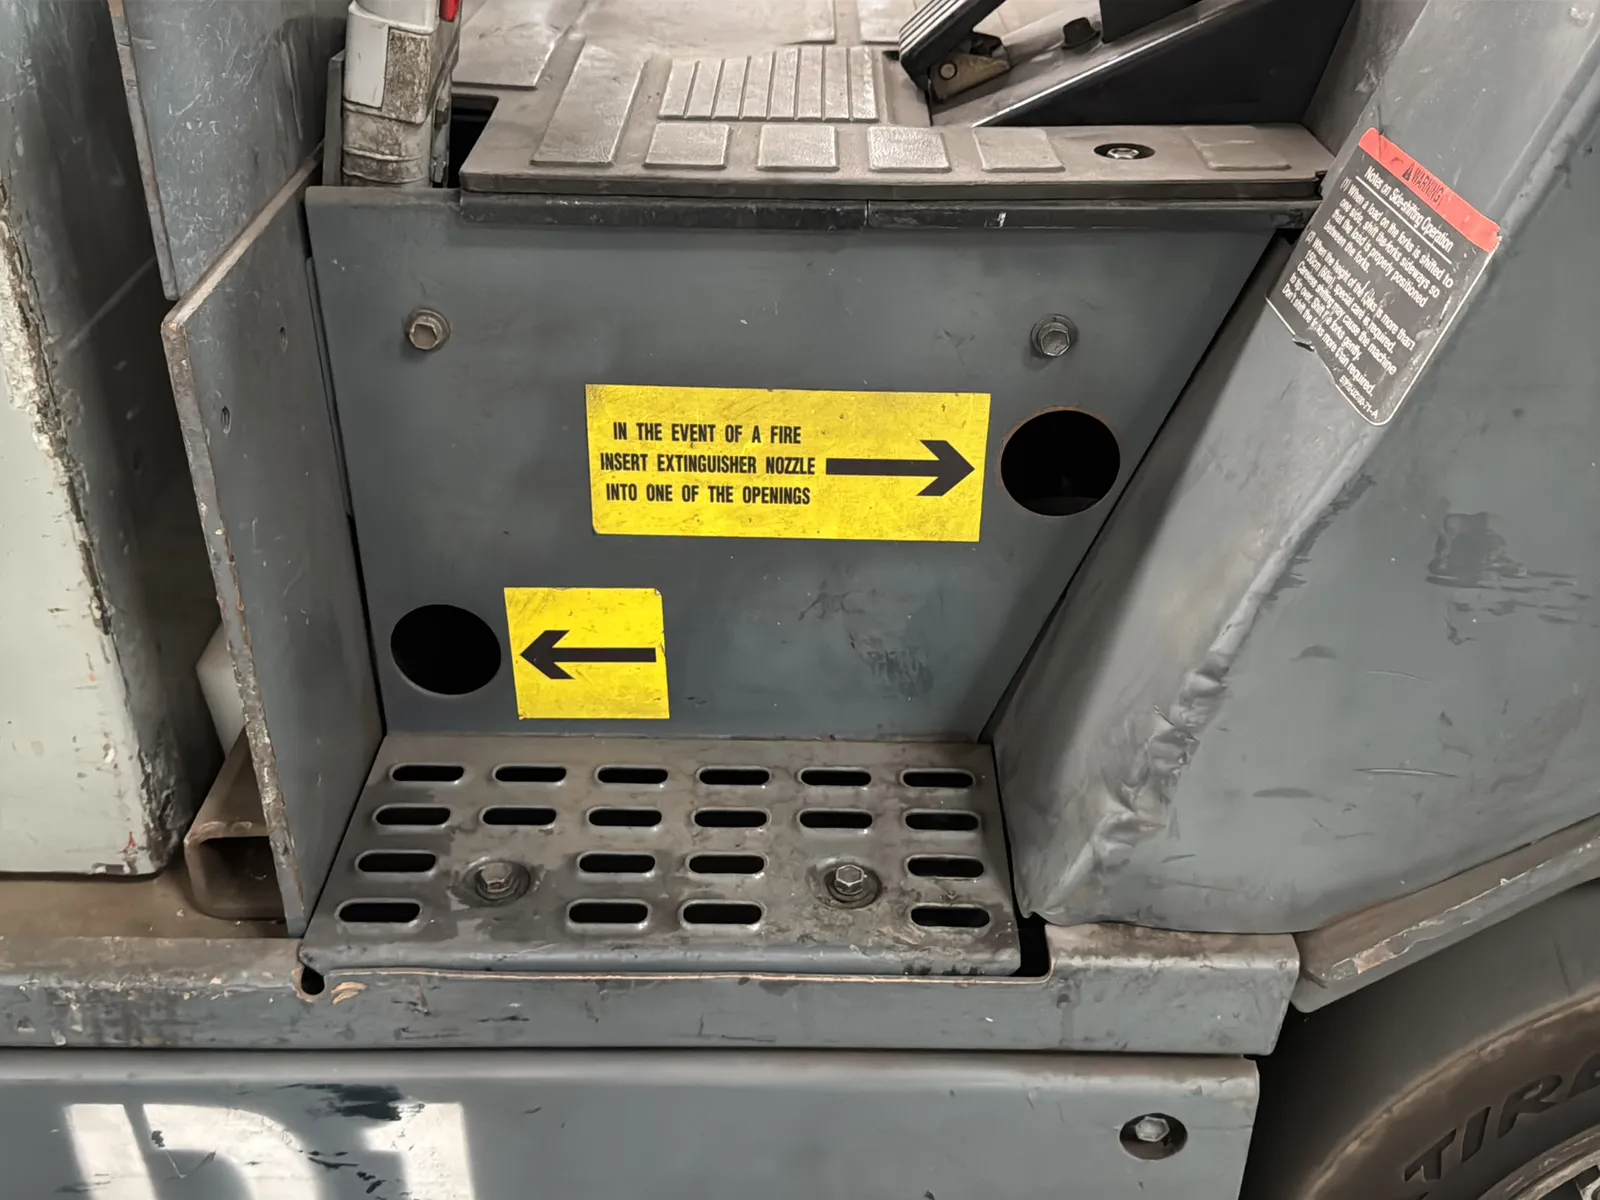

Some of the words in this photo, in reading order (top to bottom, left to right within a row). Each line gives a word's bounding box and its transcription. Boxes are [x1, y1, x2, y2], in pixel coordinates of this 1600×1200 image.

[1332, 209, 1345, 225] that
[1342, 219, 1353, 234] the
[1364, 166, 1384, 189] Notes
[1381, 184, 1392, 196] on
[1388, 187, 1424, 228] Side-shifting
[1417, 217, 1454, 253] Operation
[1324, 219, 1346, 247] between
[1344, 241, 1356, 257] the
[1353, 250, 1370, 273] forks.
[1340, 199, 1352, 212] one
[1349, 208, 1363, 227] side,
[1362, 221, 1379, 238] shift
[1375, 231, 1387, 247] the
[1385, 240, 1402, 262] forks
[1399, 257, 1430, 289] sideways
[1428, 285, 1440, 298] so
[1348, 184, 1365, 205] When
[1362, 201, 1369, 210] a
[1367, 203, 1383, 221] load
[1380, 217, 1390, 229] on
[1387, 222, 1399, 238] the
[1397, 231, 1414, 252] forks
[1412, 245, 1421, 259] is
[1419, 253, 1445, 280] shifted
[1442, 273, 1454, 288] to
[1350, 227, 1367, 246] load
[1363, 239, 1372, 252] is
[1365, 247, 1395, 277] properly
[1312, 238, 1327, 257] When
[1324, 252, 1335, 266] the
[1332, 259, 1351, 283] height
[1347, 278, 1357, 288] of
[1353, 282, 1366, 297] the
[1374, 305, 1383, 318] is
[1380, 314, 1399, 334] more
[1396, 328, 1415, 351] than
[1390, 270, 1429, 308] positioned
[1290, 272, 1297, 283] to
[1294, 278, 1303, 291] tip
[1301, 287, 1313, 303] over.
[1311, 297, 1325, 316] Shift
[1329, 319, 1345, 340] forks
[1339, 336, 1362, 361] gently.
[1297, 261, 1319, 288] Careless
[1315, 284, 1334, 309] shifting
[1331, 302, 1345, 320] may
[1342, 314, 1360, 336] cause
[1358, 330, 1370, 347] the
[1367, 343, 1397, 375] machine
[1333, 284, 1355, 307] special
[1350, 303, 1366, 320] care
[1362, 313, 1370, 326] is
[1367, 320, 1396, 354] required.
[1282, 283, 1296, 303] Don't
[1293, 299, 1306, 314] shift
[1302, 308, 1313, 323] the
[1322, 333, 1337, 352] more
[1347, 359, 1376, 397] required.
[613, 422, 628, 440] IN
[636, 422, 663, 441] THE
[671, 423, 716, 443] EVENT
[725, 424, 743, 443] OF
[751, 425, 761, 443] A
[770, 425, 801, 444] FIRE
[600, 452, 648, 471] INSERT
[657, 453, 757, 474] EXTINGUISHER
[765, 456, 816, 475] NOZZLE
[606, 483, 637, 501] INTO
[646, 484, 673, 502] ONE
[682, 484, 699, 502] OF
[707, 485, 734, 503] THE
[742, 486, 811, 505] OPENINGS
